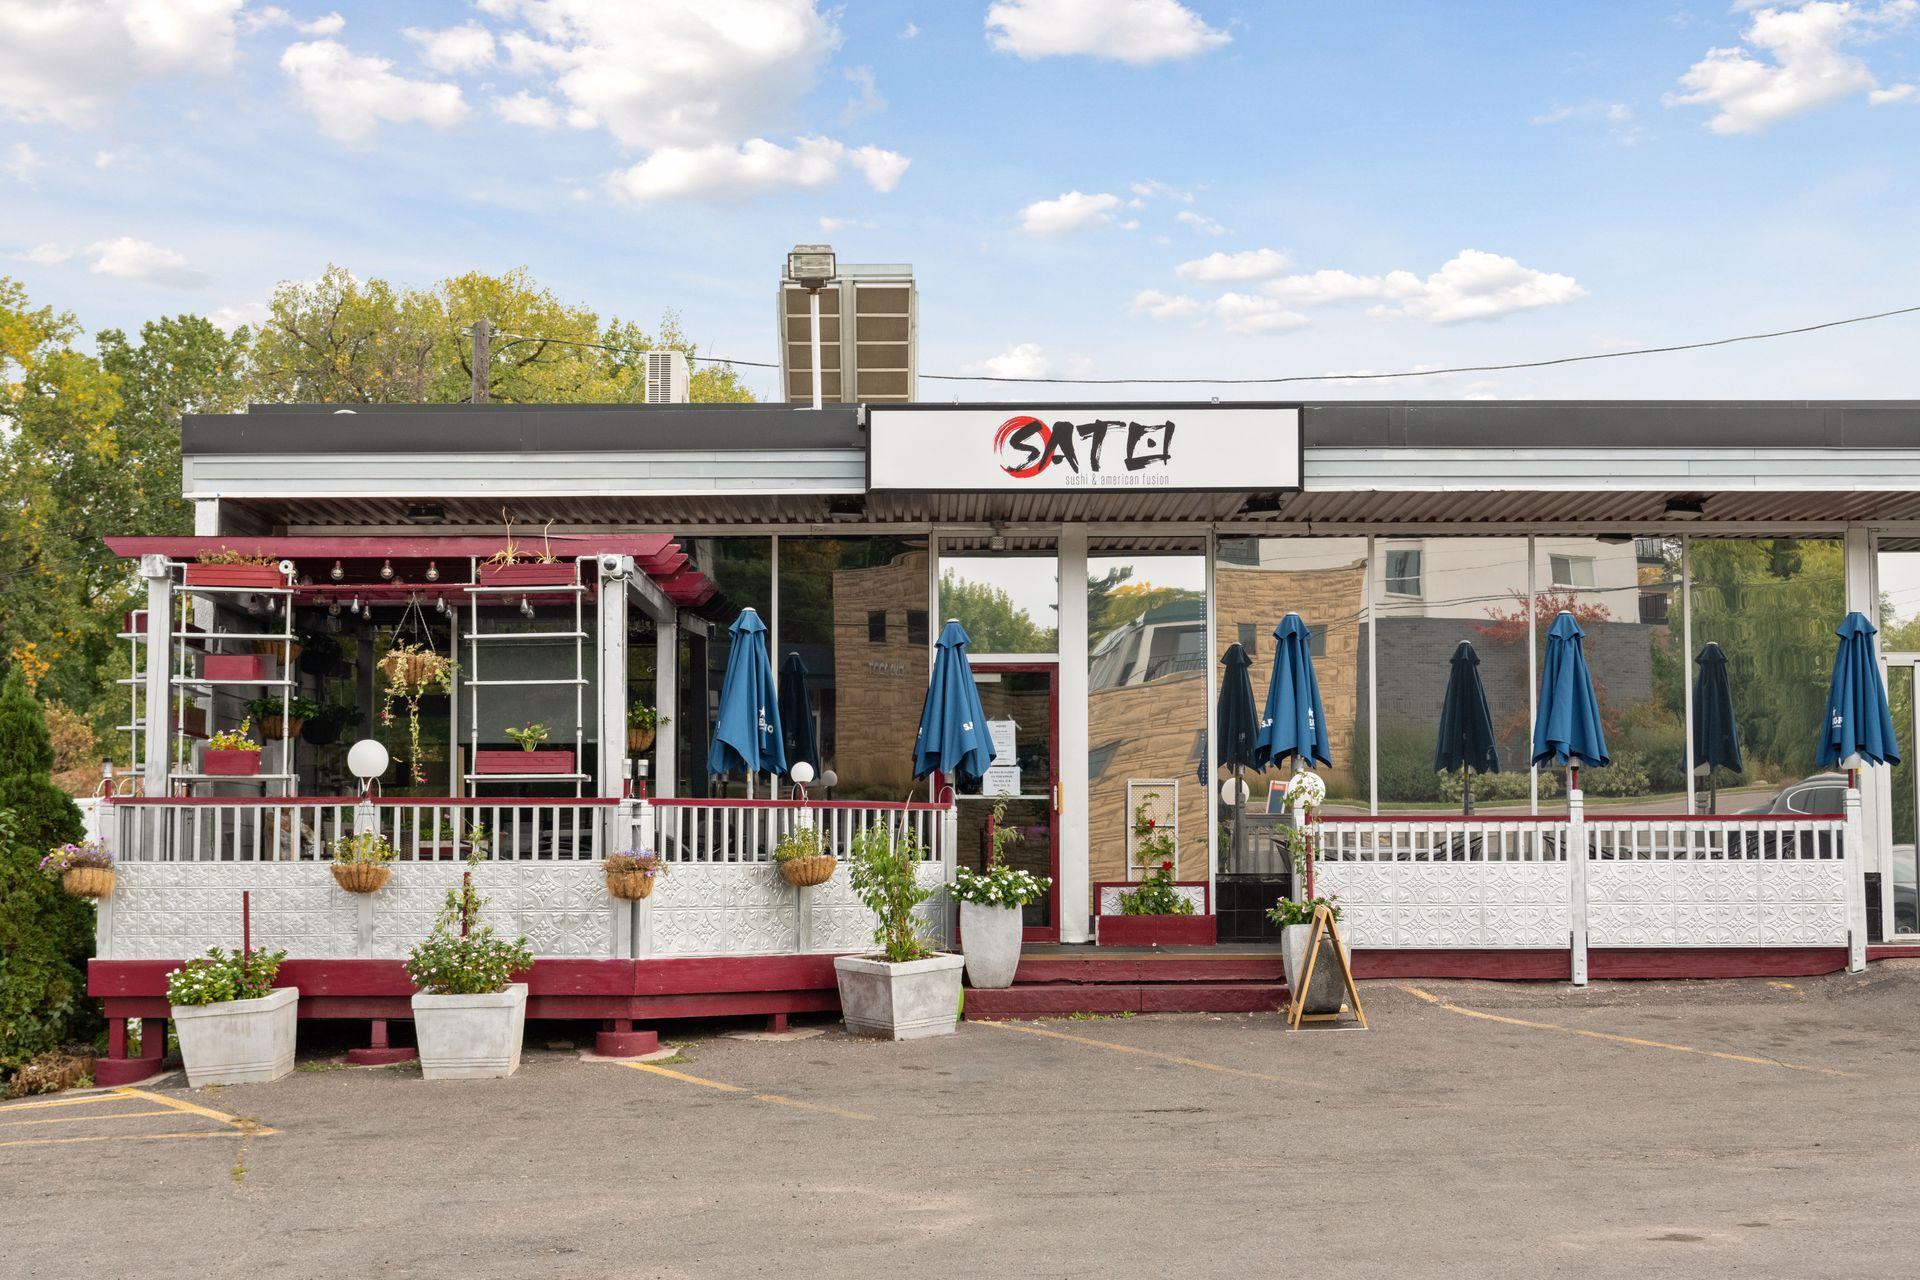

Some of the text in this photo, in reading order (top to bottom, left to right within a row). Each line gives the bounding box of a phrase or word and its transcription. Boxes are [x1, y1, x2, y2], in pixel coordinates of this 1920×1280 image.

[1007, 419, 1175, 474] SATO
[1065, 474, 1170, 485] sushi & american fusion
